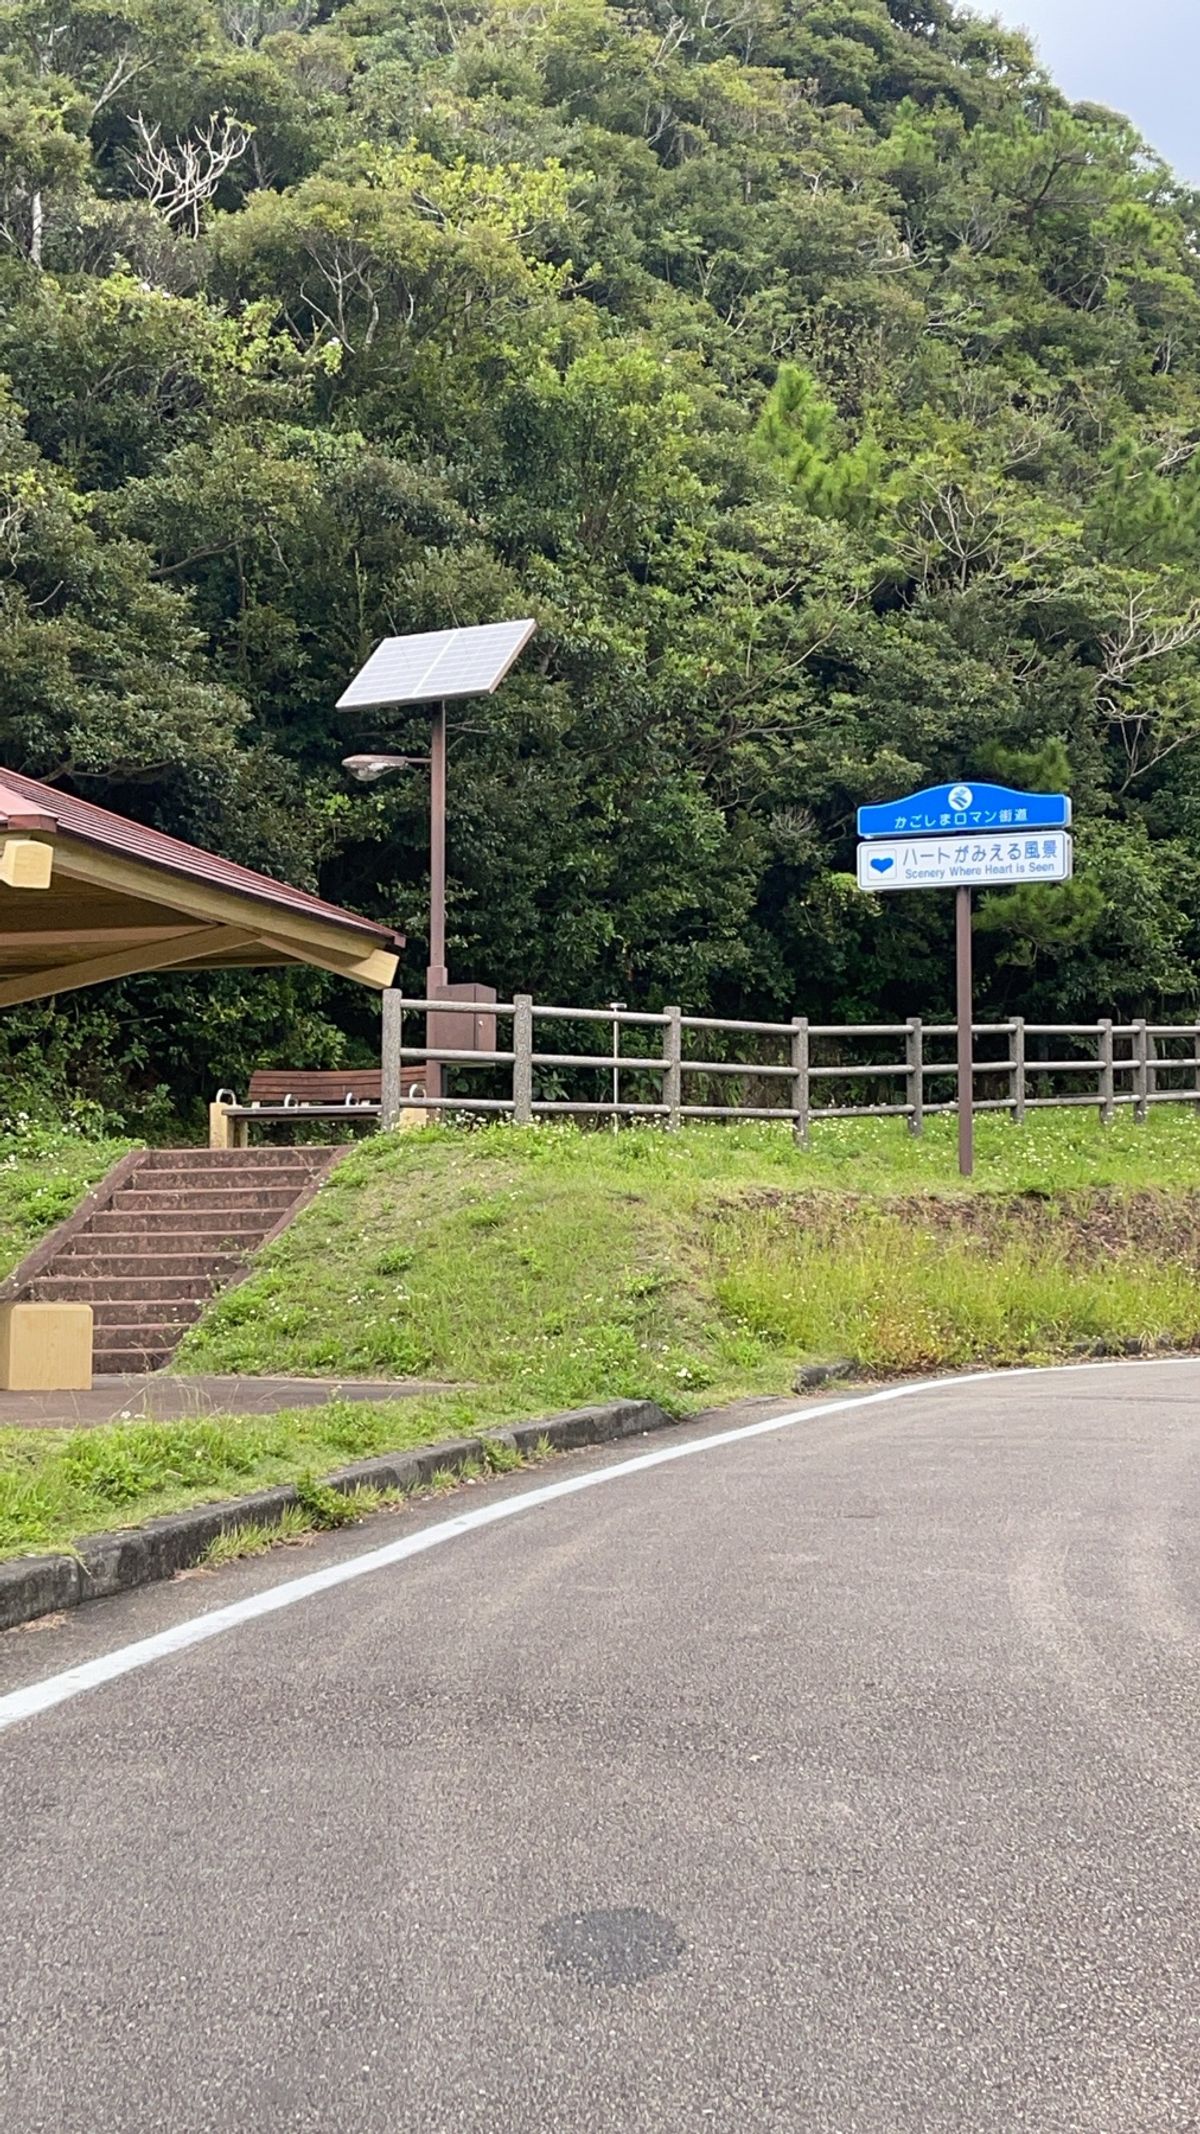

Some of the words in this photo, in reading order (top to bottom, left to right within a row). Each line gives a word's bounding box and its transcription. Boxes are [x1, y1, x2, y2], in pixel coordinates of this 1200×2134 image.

[894, 808, 1028, 829] かごしまロマン街道
[903, 840, 1058, 866] ハートがみえる風景
[905, 868, 945, 880] Scenery
[950, 866, 981, 876] Where
[985, 864, 1012, 874] Heart
[1016, 863, 1025, 873] is
[1029, 862, 1055, 872] Seen
